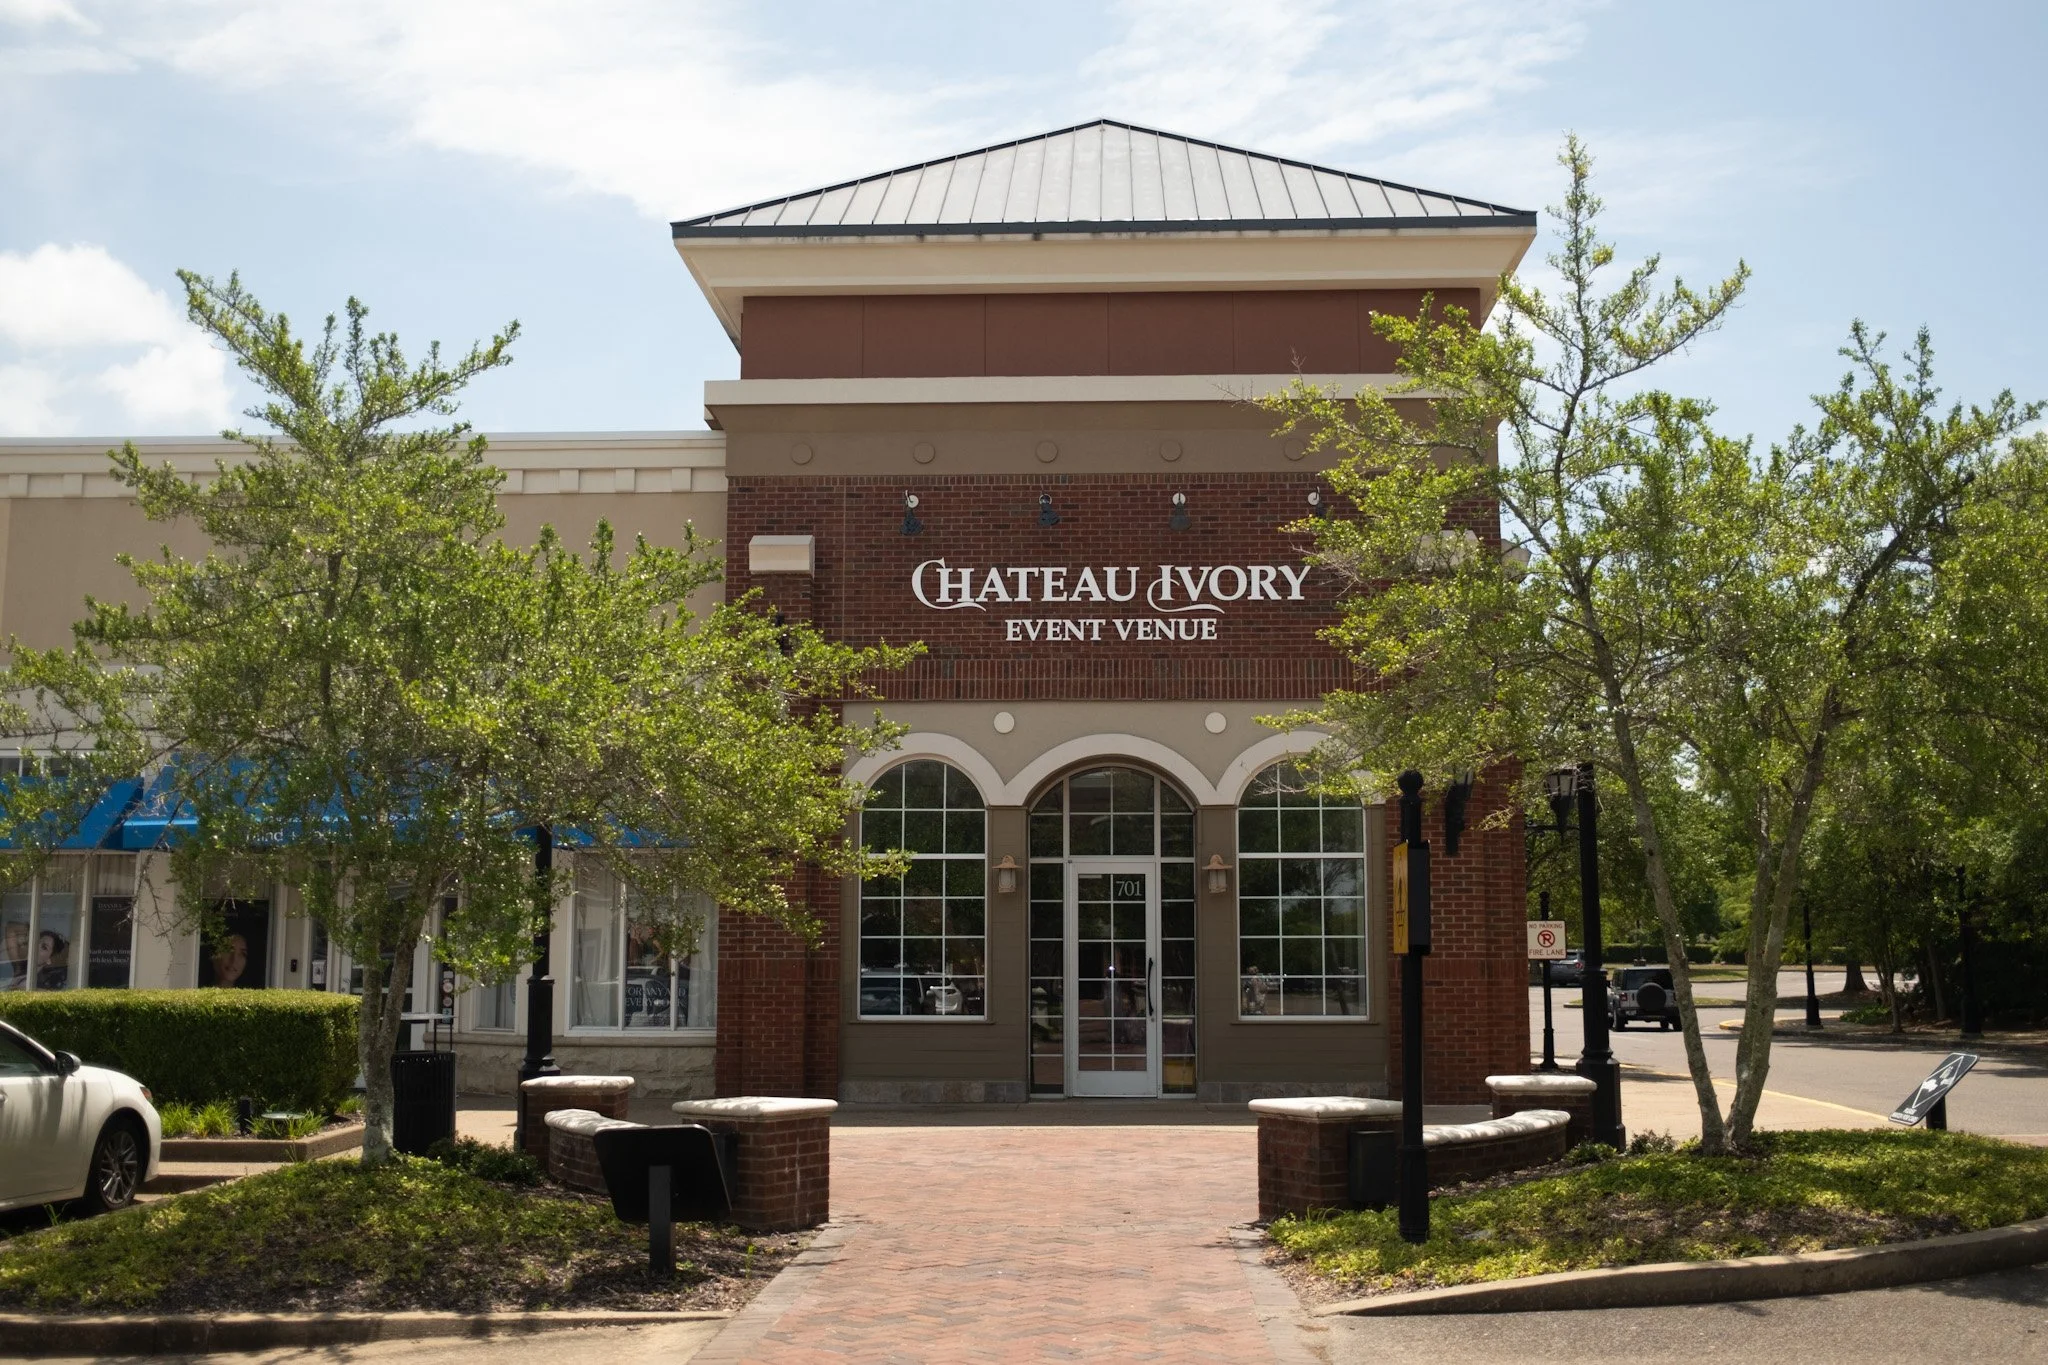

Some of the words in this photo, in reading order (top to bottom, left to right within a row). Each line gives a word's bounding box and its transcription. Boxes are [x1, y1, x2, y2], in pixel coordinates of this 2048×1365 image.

[911, 557, 1140, 612] CHATEAU
[1146, 564, 1311, 614] IVORY
[1005, 619, 1106, 641] EVENT
[1111, 618, 1218, 641] VENUE
[1115, 880, 1142, 897] 701
